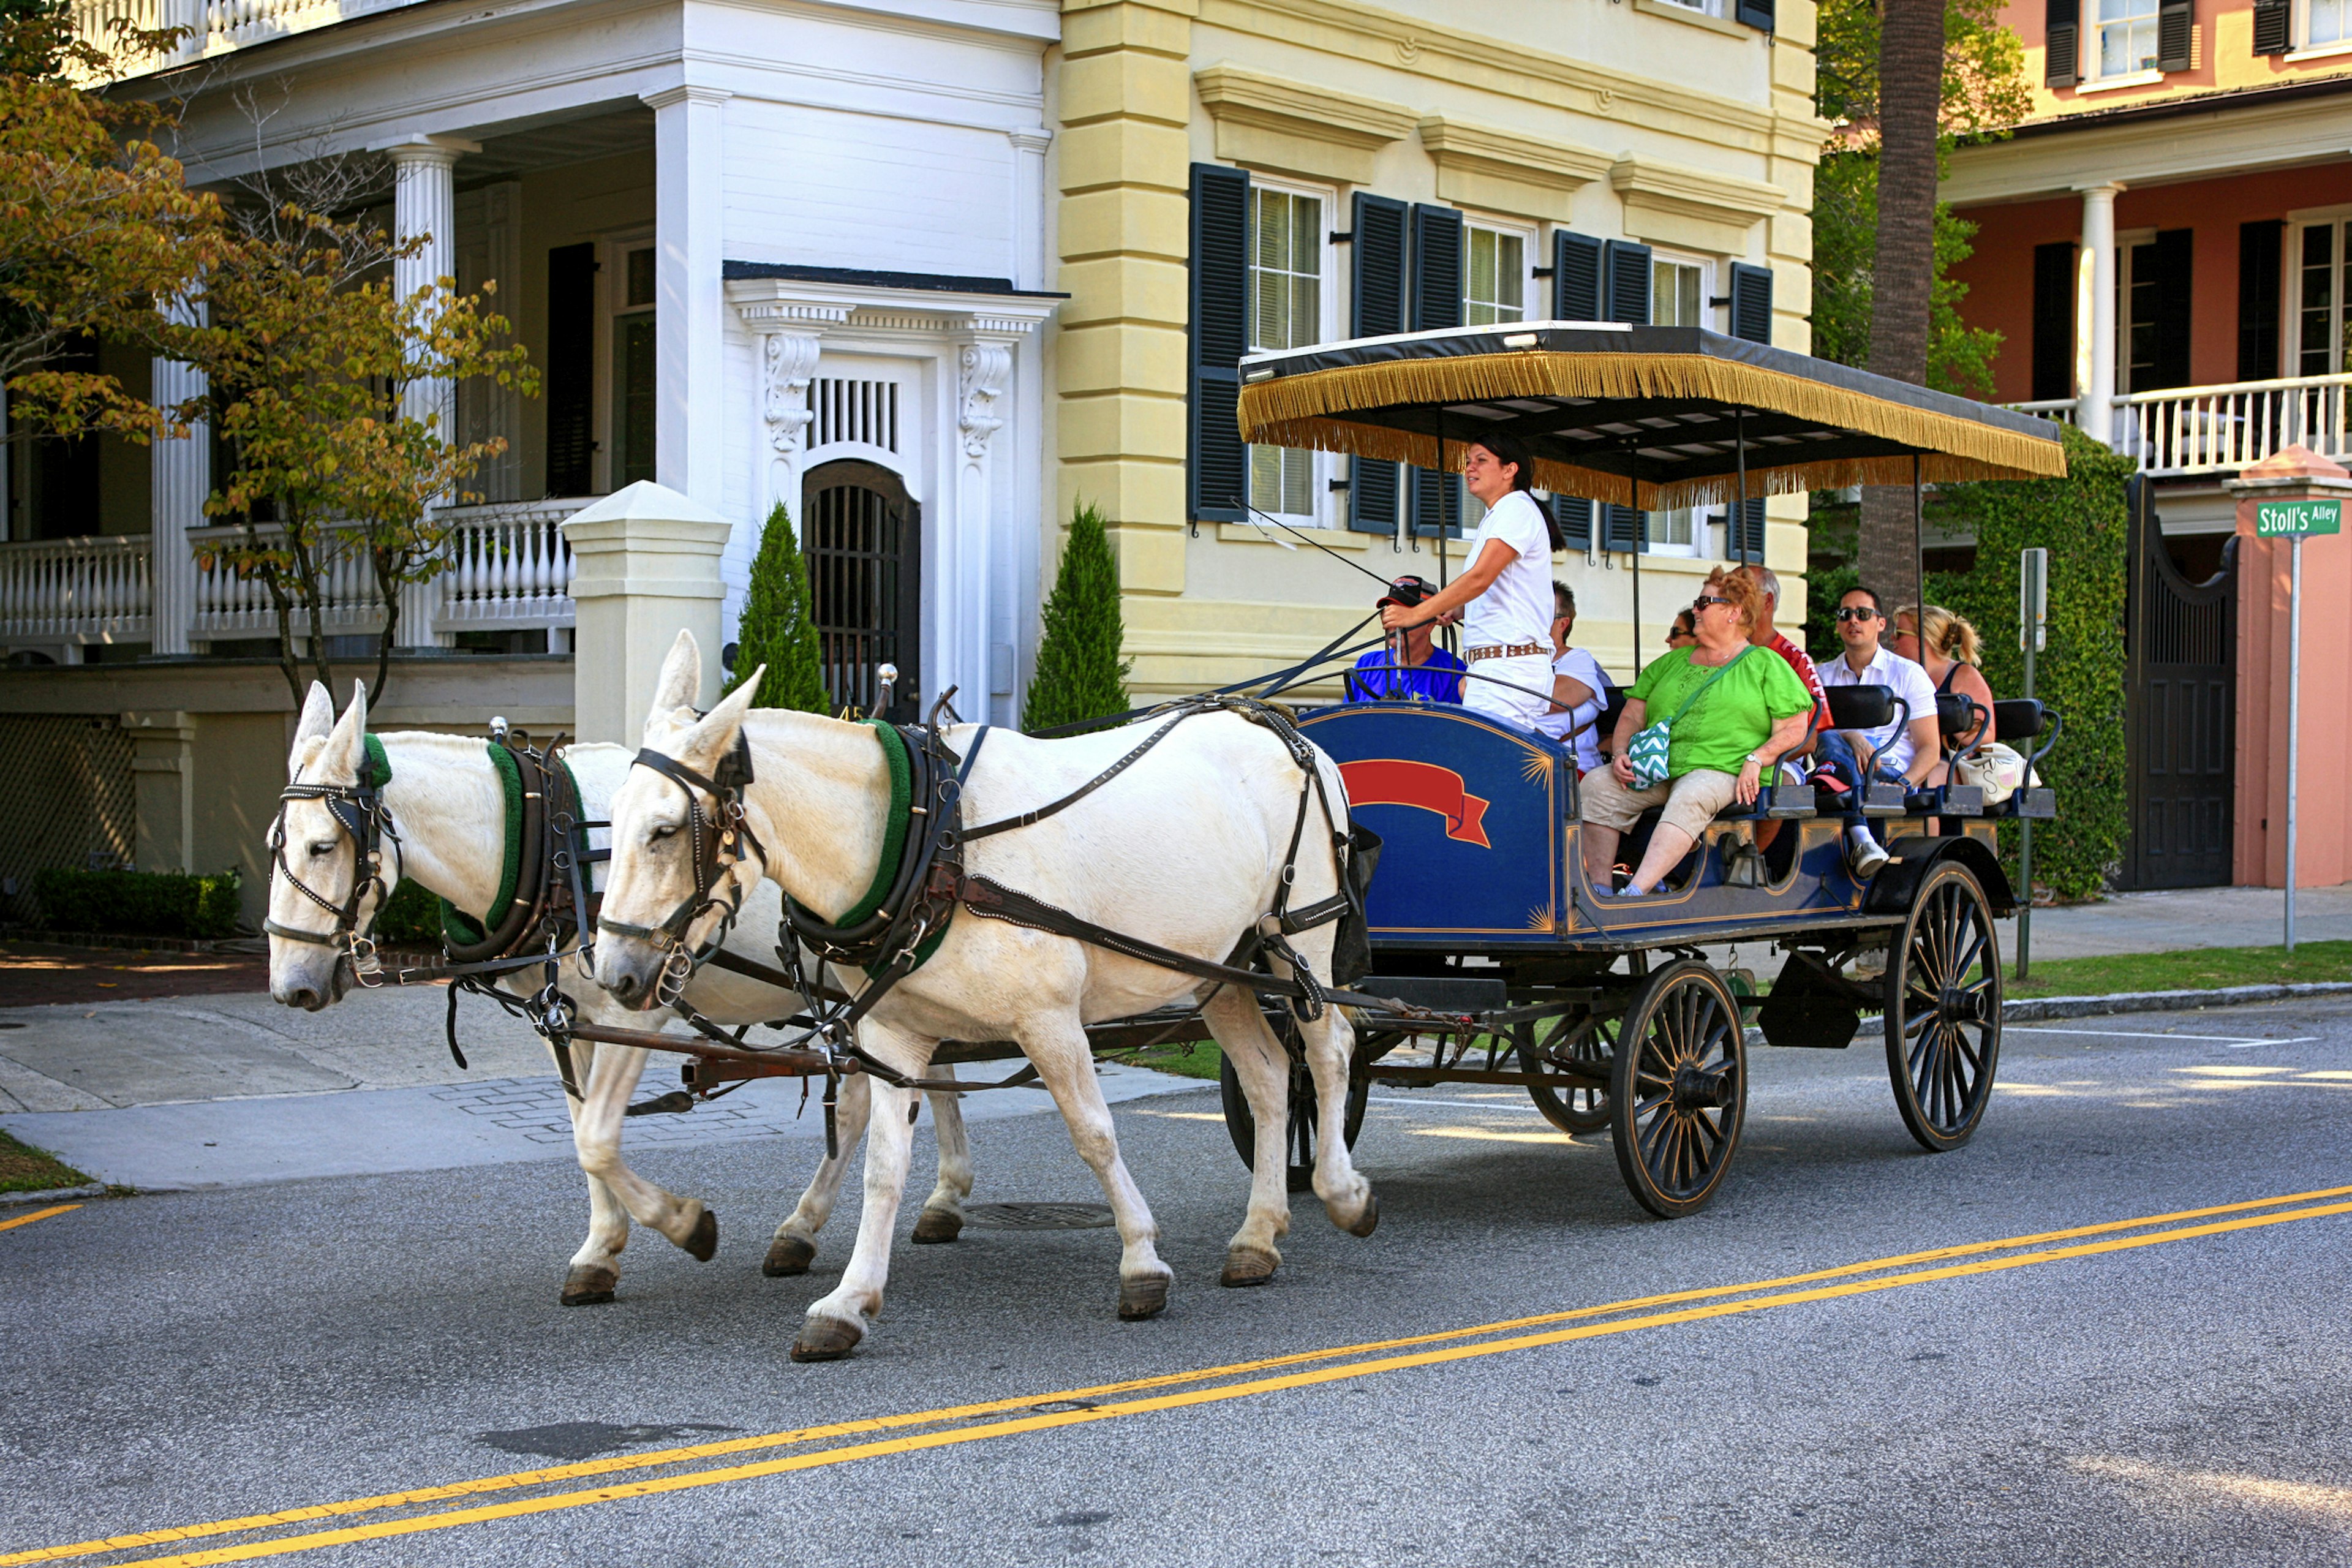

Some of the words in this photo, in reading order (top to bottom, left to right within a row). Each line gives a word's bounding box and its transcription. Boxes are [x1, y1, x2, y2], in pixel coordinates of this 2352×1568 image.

[2260, 507, 2309, 532] Stoll's
[2312, 505, 2338, 523] Alley
[839, 706, 864, 722] 45
